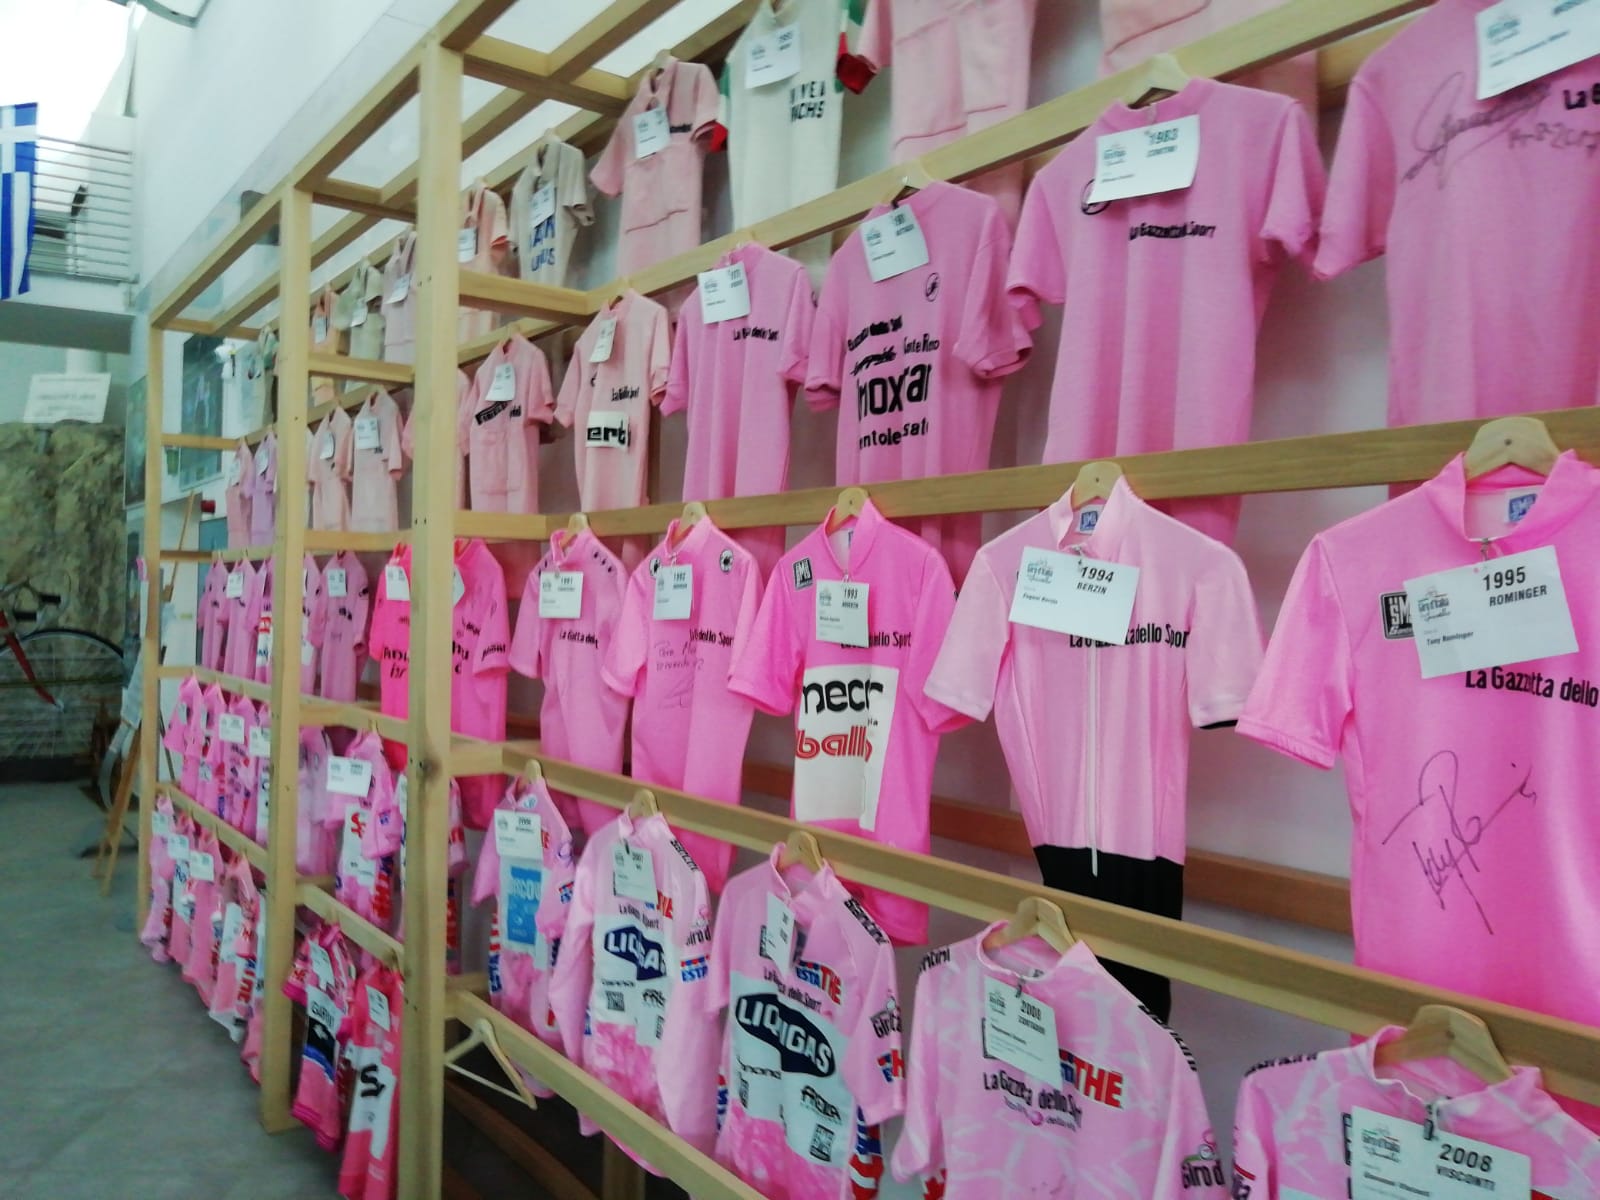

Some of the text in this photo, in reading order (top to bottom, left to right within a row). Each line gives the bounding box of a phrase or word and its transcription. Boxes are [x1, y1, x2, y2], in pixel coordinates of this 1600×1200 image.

[1081, 566, 1115, 583] 1994
[1483, 566, 1526, 590] 1995
[843, 588, 858, 600] 1993
[1076, 582, 1107, 595] BERZIN
[1489, 585, 1547, 607] ROMINGER
[1165, 624, 1191, 648] Spor
[1465, 669, 1488, 688] La
[1560, 676, 1599, 708] dello
[1439, 1143, 1493, 1173] 2008
[1436, 1164, 1496, 1192] VISCONTI
